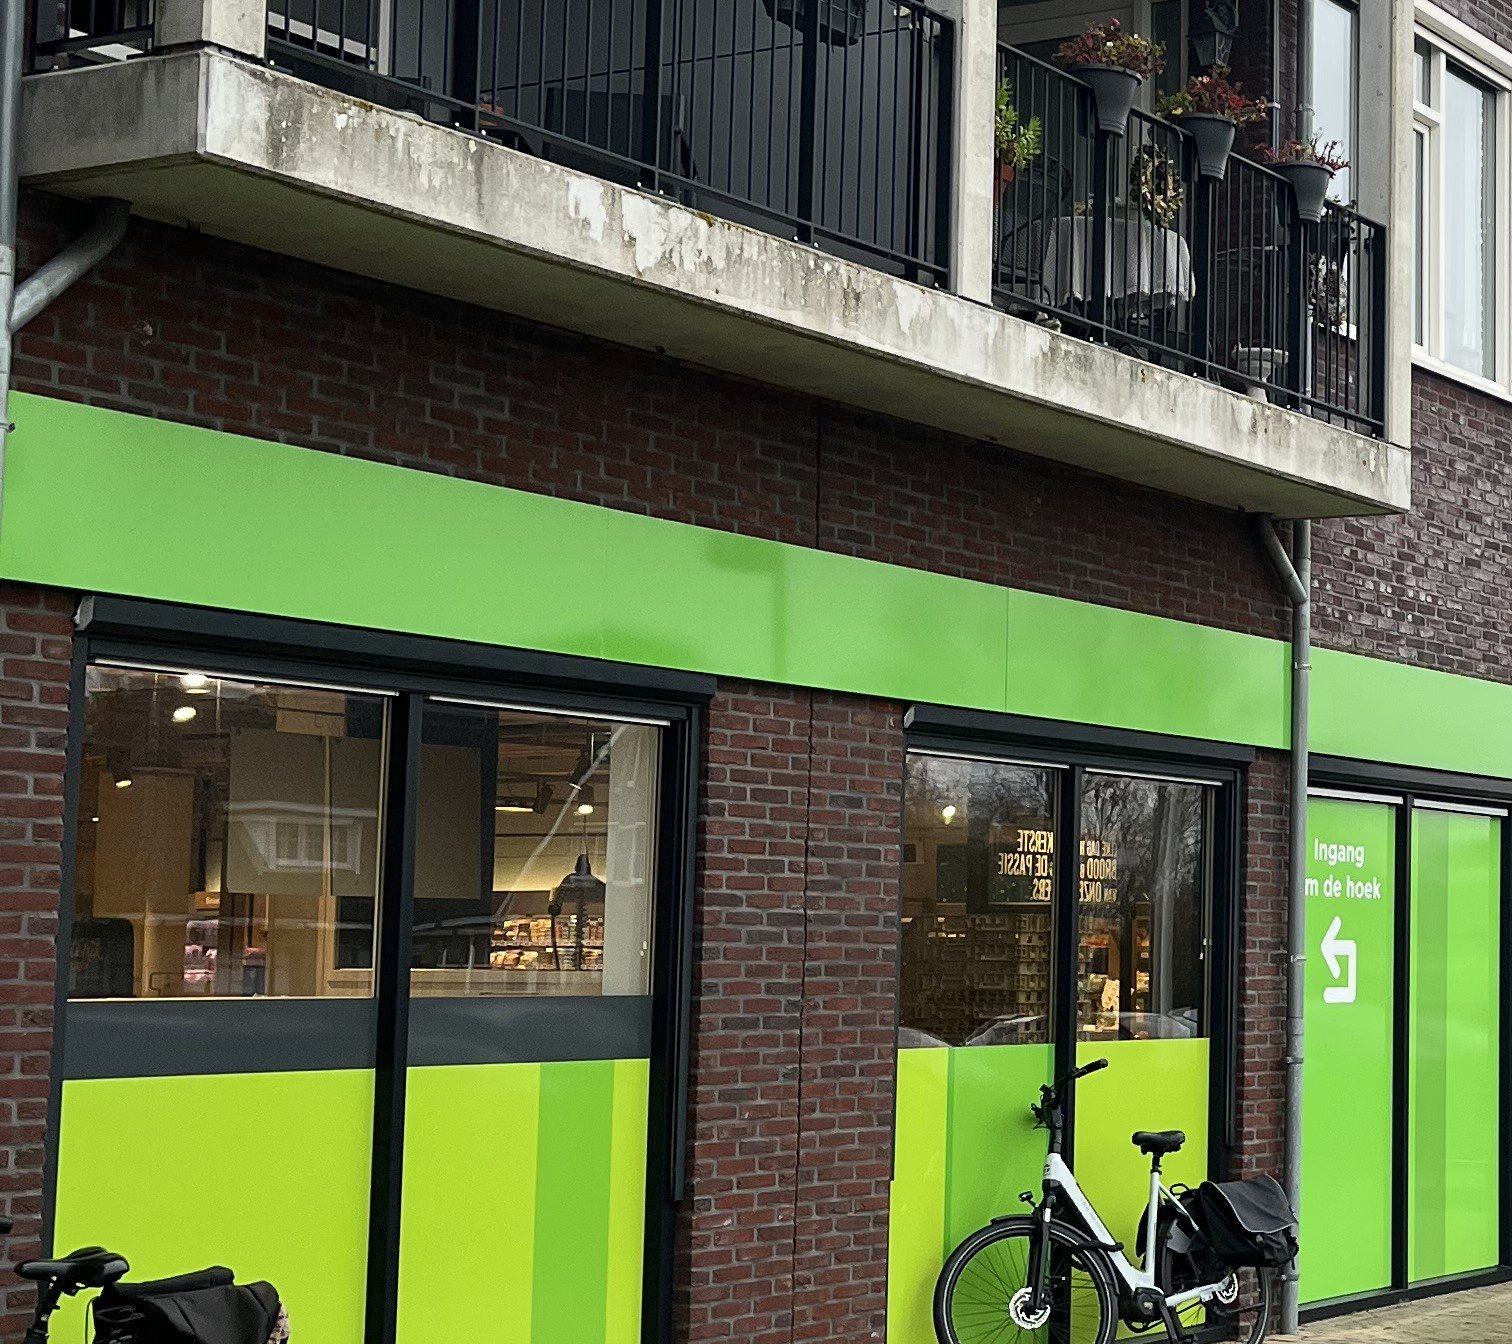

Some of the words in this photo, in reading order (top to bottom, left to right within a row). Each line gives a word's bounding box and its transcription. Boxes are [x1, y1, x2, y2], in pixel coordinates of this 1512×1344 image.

[1314, 837, 1365, 868] Ingang
[1304, 877, 1319, 896] m
[1323, 873, 1342, 898] de
[1346, 874, 1382, 900] hoek
